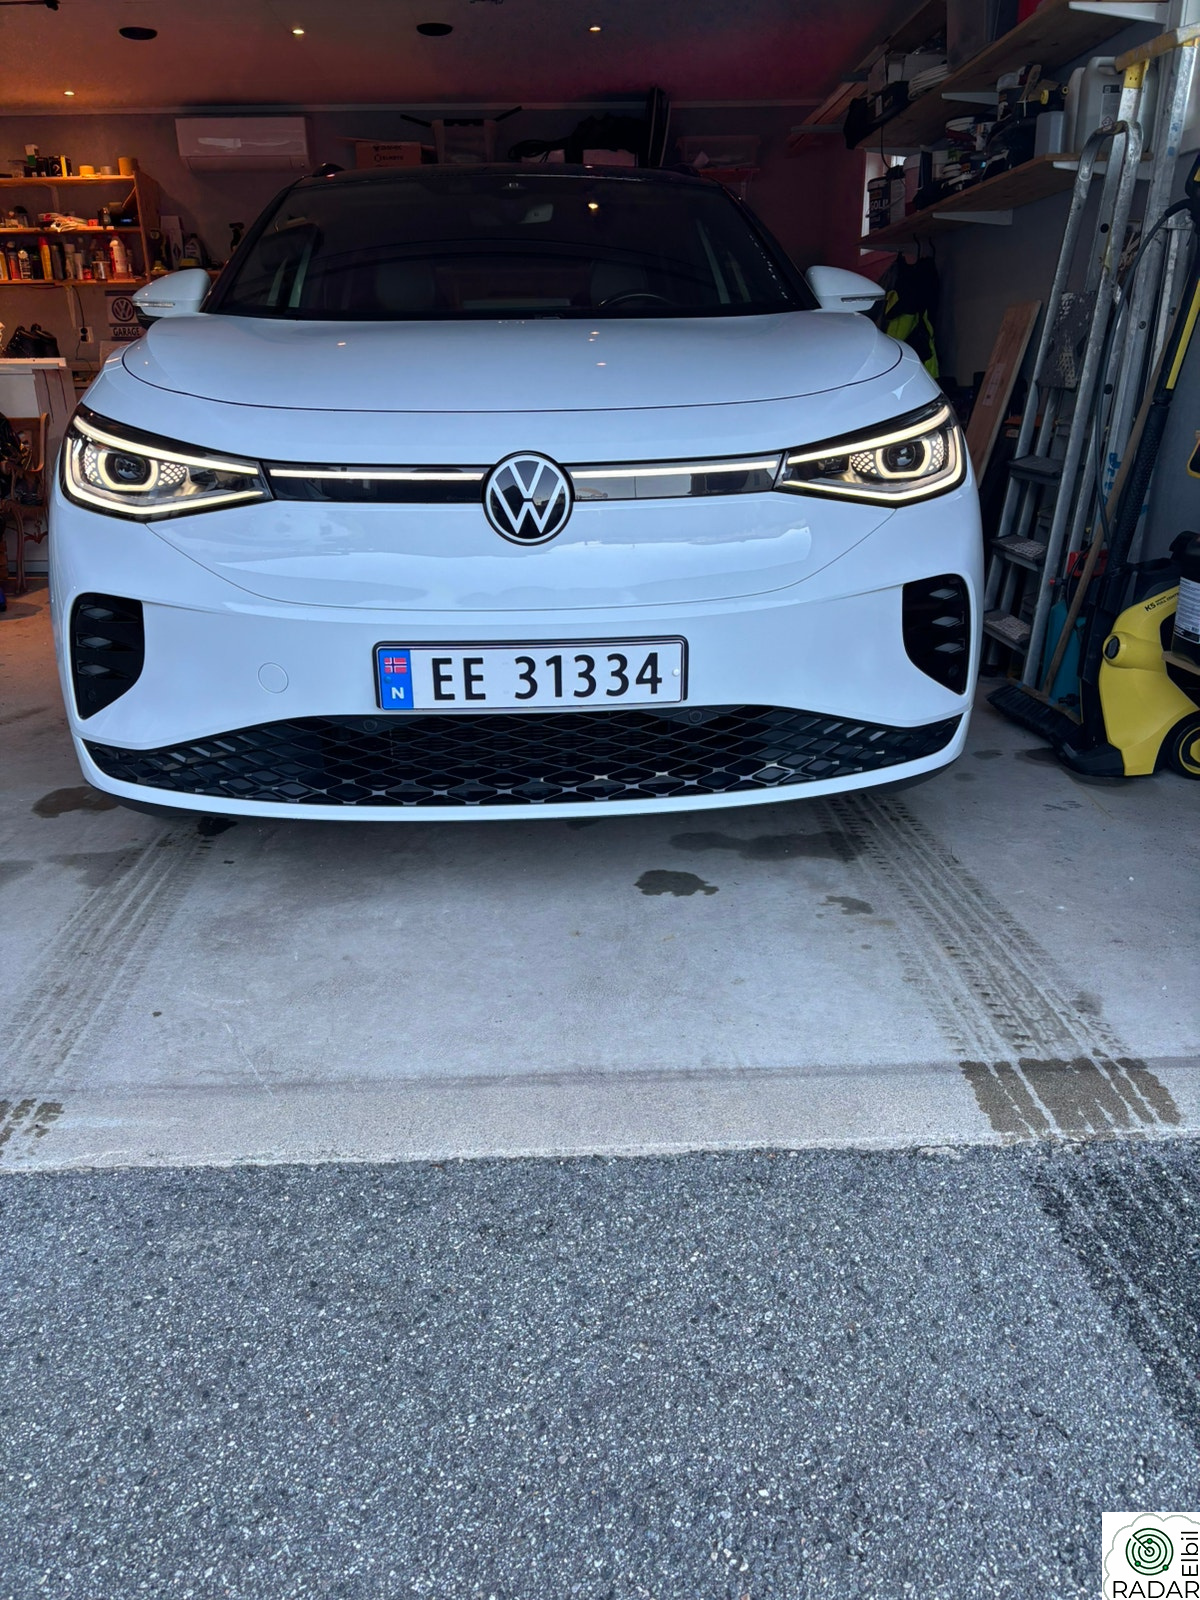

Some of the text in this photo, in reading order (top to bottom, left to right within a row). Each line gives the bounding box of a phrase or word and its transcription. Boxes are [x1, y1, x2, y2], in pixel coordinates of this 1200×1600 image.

[113, 327, 140, 336] GARAGE
[488, 457, 568, 538] VW
[1144, 602, 1156, 611] K5
[431, 652, 663, 701] EE 31334
[391, 687, 404, 699] N
